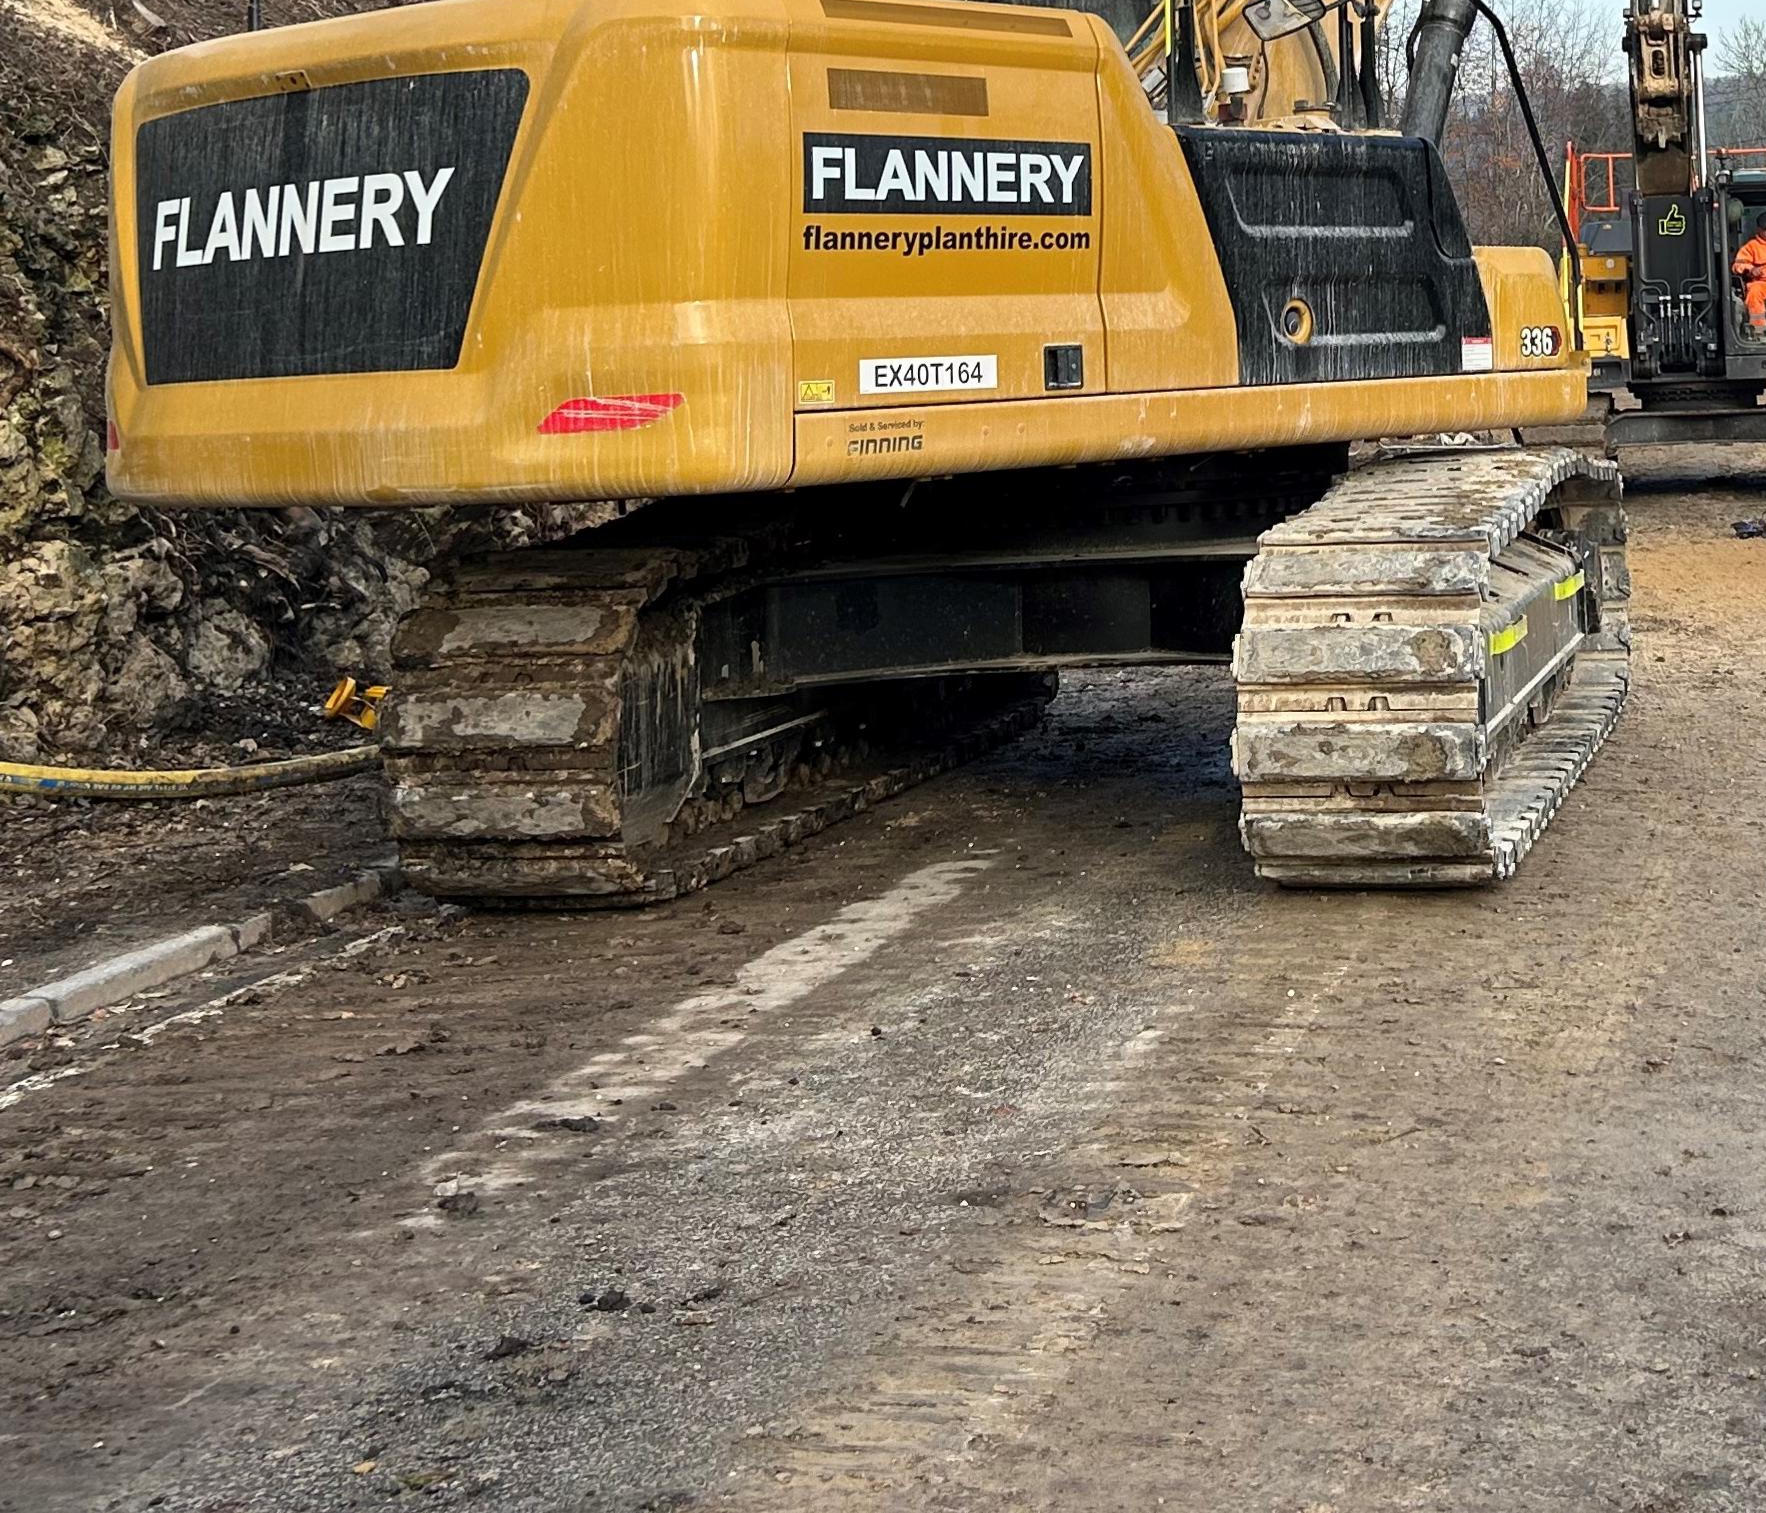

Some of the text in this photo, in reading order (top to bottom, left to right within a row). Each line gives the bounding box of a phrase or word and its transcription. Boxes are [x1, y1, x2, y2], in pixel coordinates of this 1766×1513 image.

[811, 146, 1084, 203] FLANNERY
[152, 167, 455, 271] FLANNERY
[803, 225, 1090, 256] flanneryplanthire.com
[1520, 327, 1553, 357] 336
[874, 361, 983, 388] EX40T164
[847, 435, 923, 456] FINNING
